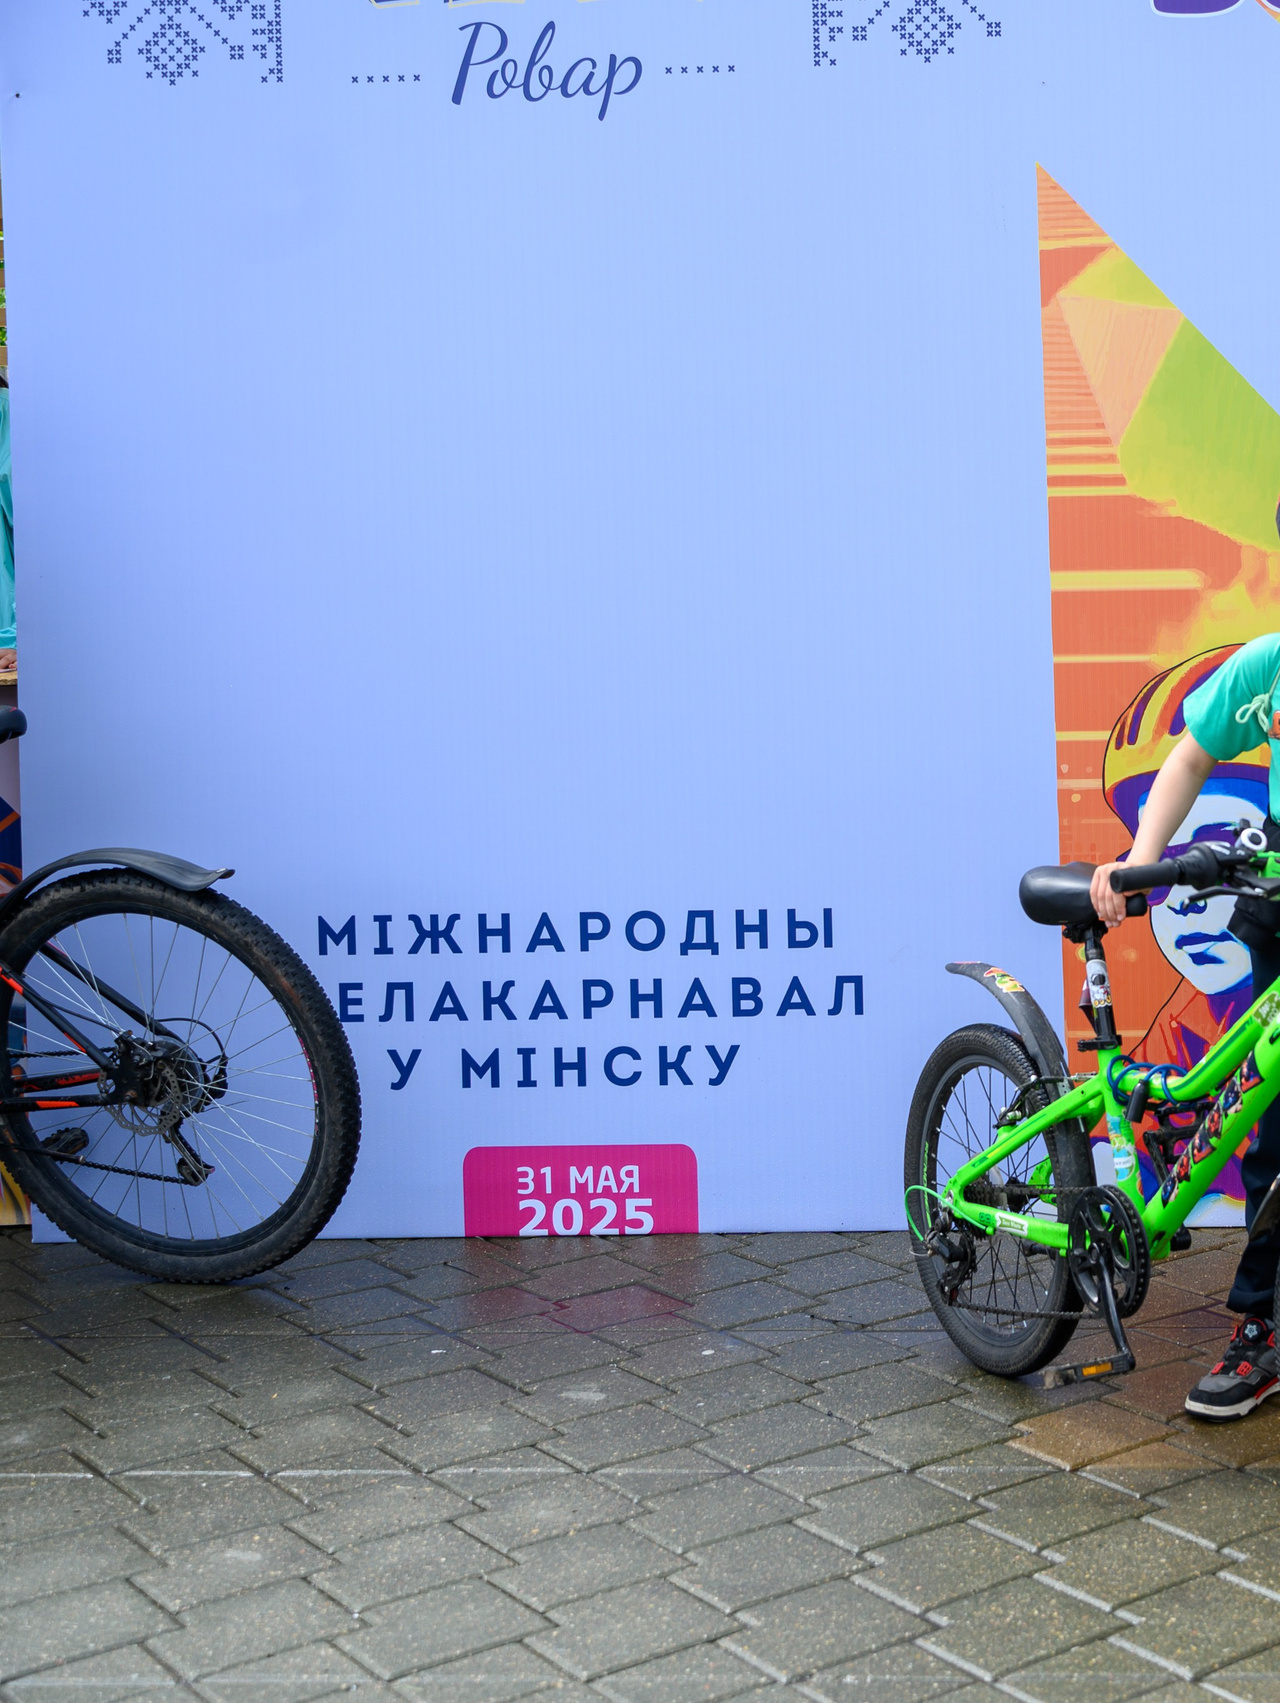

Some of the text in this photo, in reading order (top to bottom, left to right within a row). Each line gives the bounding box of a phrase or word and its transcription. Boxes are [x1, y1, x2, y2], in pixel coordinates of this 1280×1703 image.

[451, 20, 643, 121] Ровар
[317, 907, 834, 956] МІЖНАРОДНЫ
[339, 975, 864, 1023] ЕЛАКАРНАВАЛ
[387, 1044, 741, 1091] У МІНСКУ
[517, 1164, 640, 1195] 31 МАЯ
[518, 1197, 655, 1236] 2025
